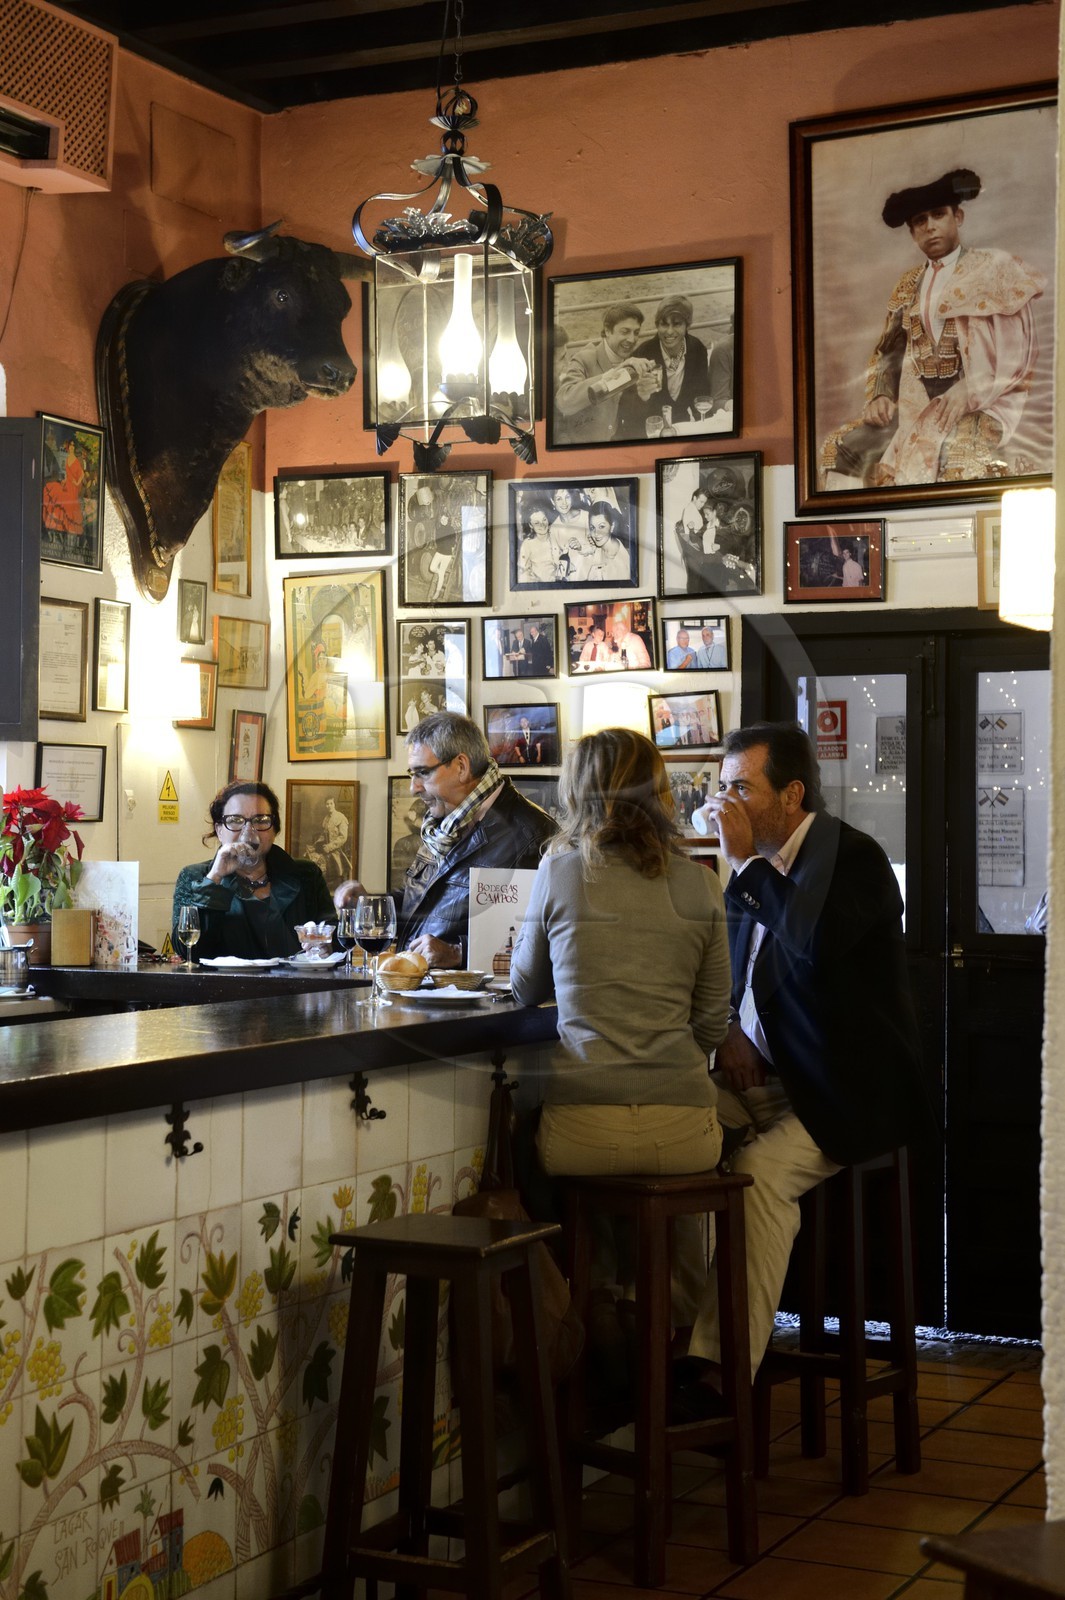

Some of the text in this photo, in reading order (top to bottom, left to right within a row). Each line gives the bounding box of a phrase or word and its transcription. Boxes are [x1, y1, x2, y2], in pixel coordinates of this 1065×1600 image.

[476, 892, 519, 905] CAMPOS
[477, 882, 518, 894] BODEGAS
[51, 1511, 92, 1544] LAGAR
[51, 1541, 78, 1586] SAN
